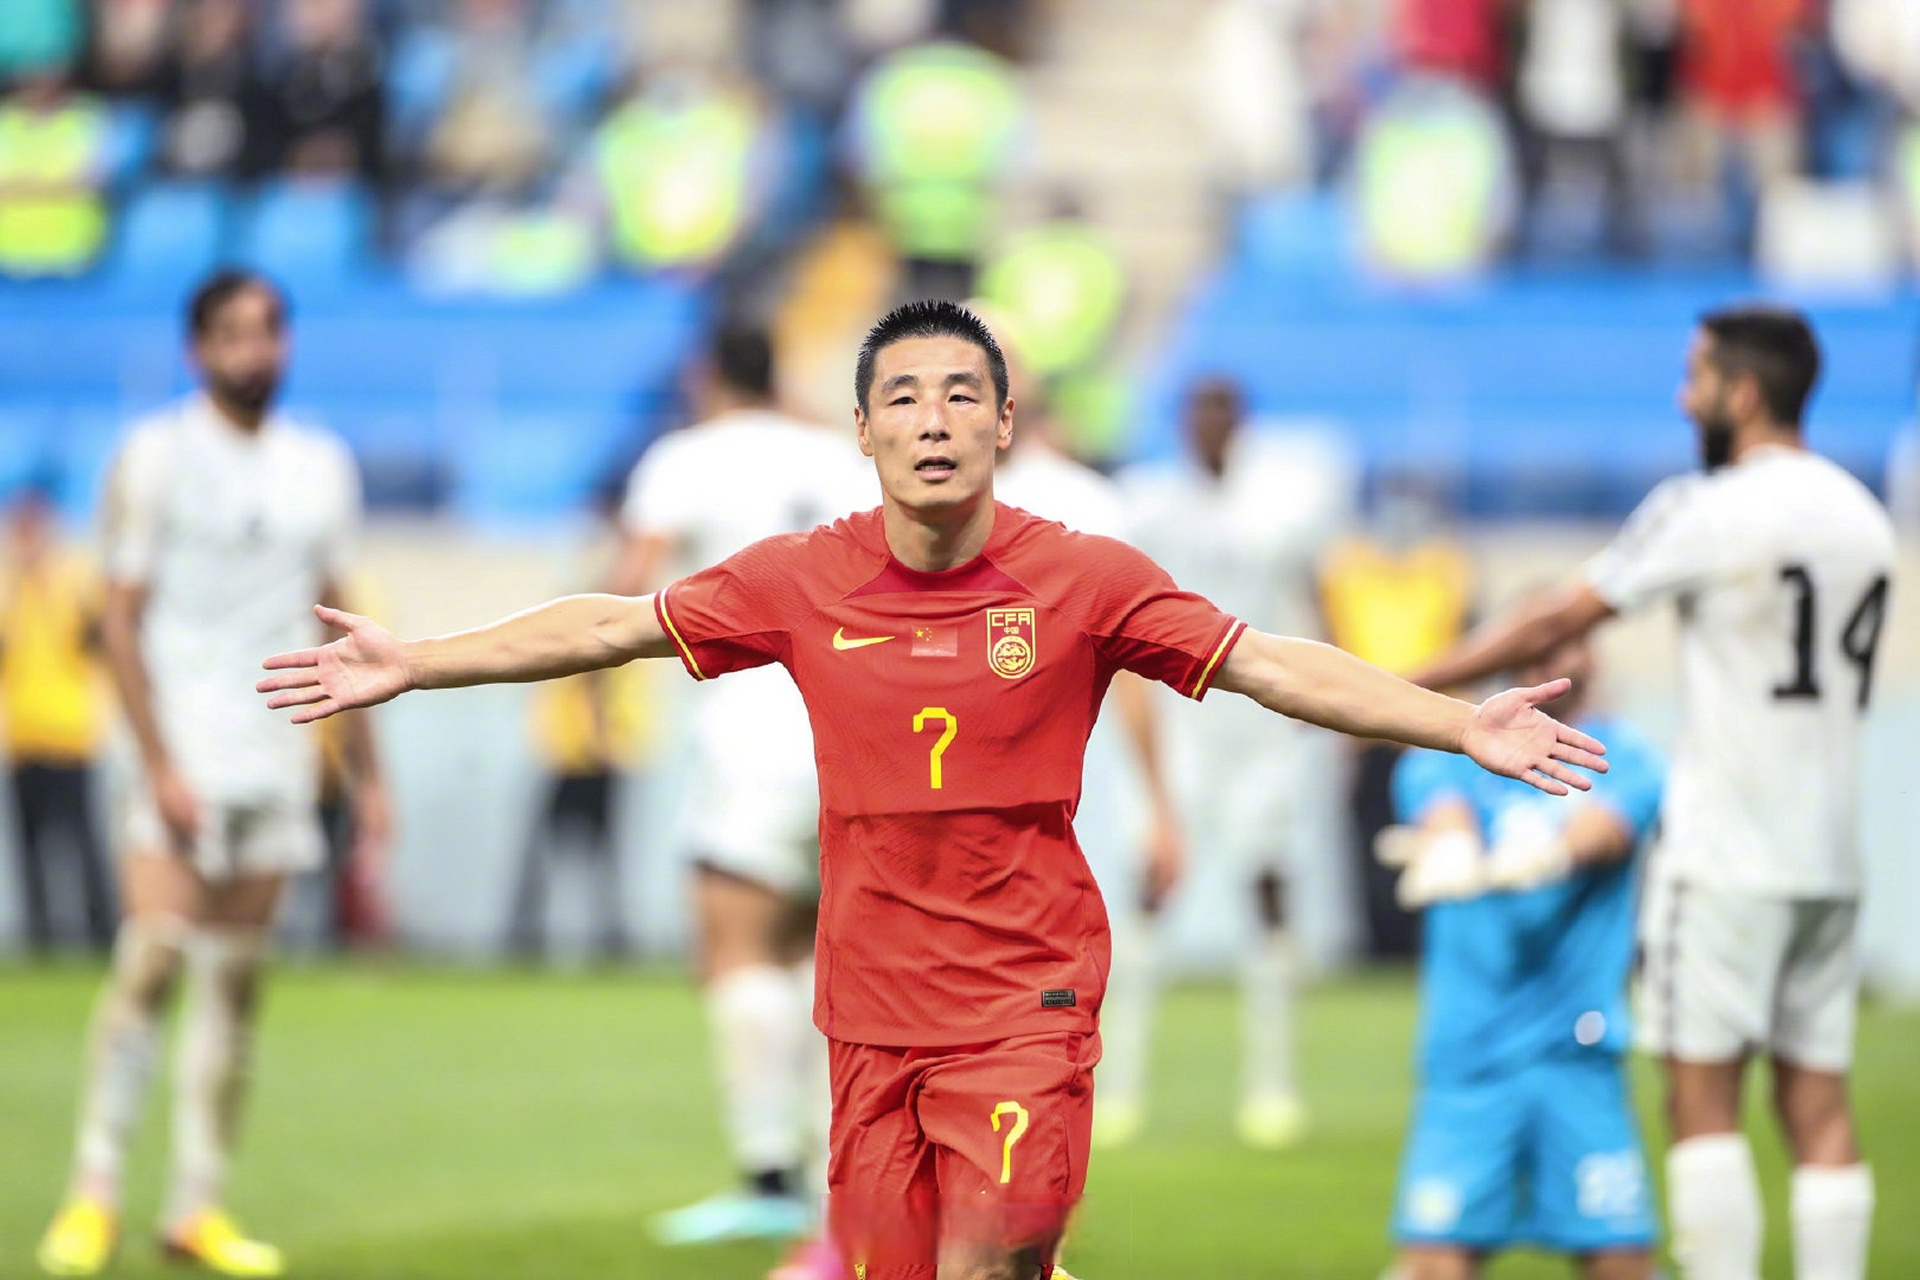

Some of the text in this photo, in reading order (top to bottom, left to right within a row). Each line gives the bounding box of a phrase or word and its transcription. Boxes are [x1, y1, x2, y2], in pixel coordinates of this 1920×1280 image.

[992, 613, 1031, 627] CFA
[1771, 564, 1889, 713] 14
[912, 706, 958, 789] 7
[990, 1100, 1029, 1184] 7
